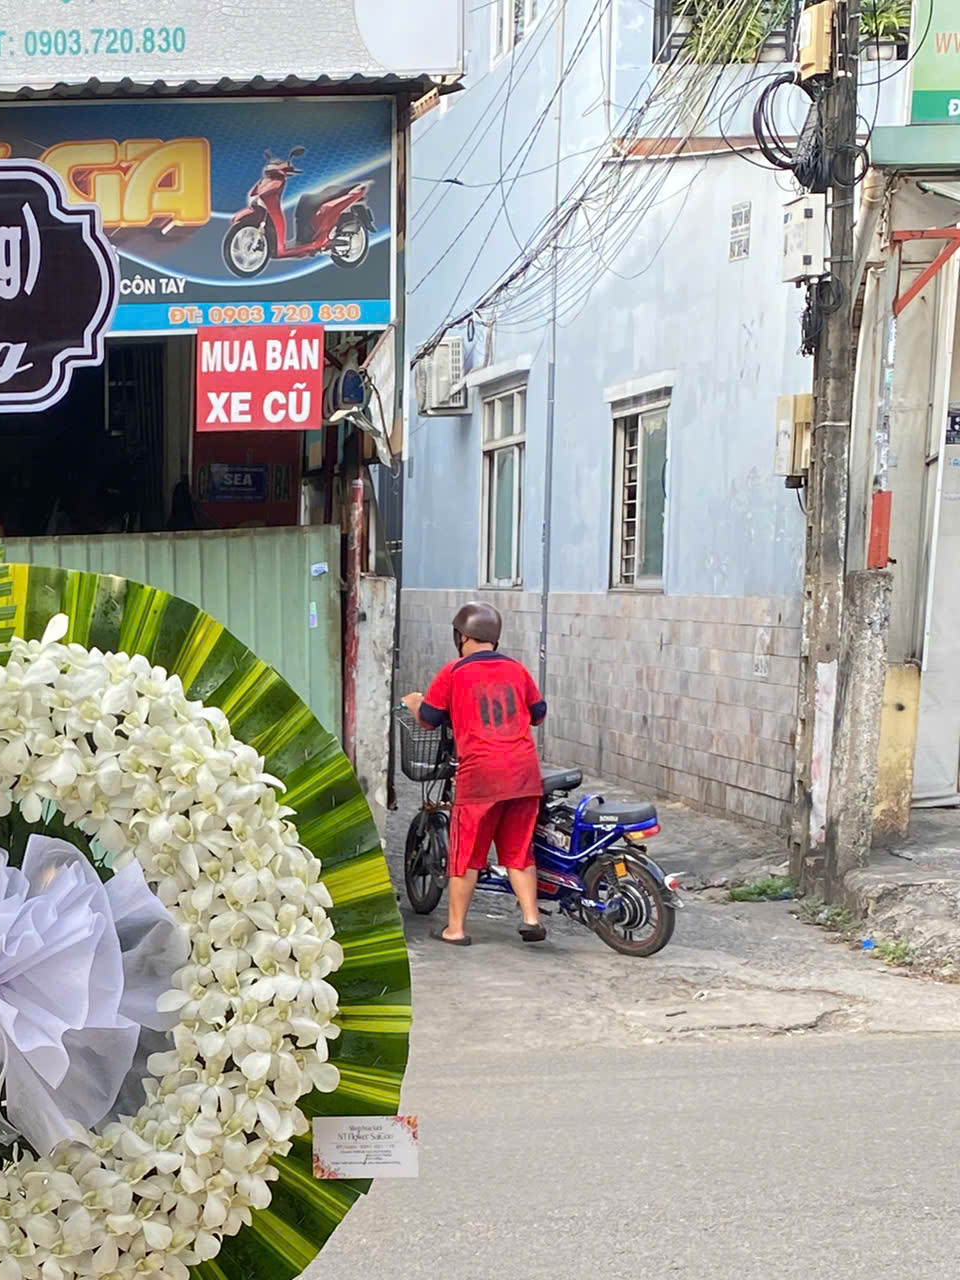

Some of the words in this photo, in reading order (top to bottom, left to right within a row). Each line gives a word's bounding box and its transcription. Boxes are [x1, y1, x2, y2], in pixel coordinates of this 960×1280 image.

[23, 27, 186, 57] 0903.720.830
[119, 274, 156, 295] CÔN
[159, 277, 187, 295] TAY
[208, 306, 264, 324] 0903
[271, 305, 313, 322] 720
[319, 303, 361, 321] 830
[200, 339, 258, 373] MUA
[265, 329, 320, 371] BÁN
[205, 391, 252, 424] XE
[262, 382, 311, 424] CŨ
[224, 473, 253, 486] SEA
